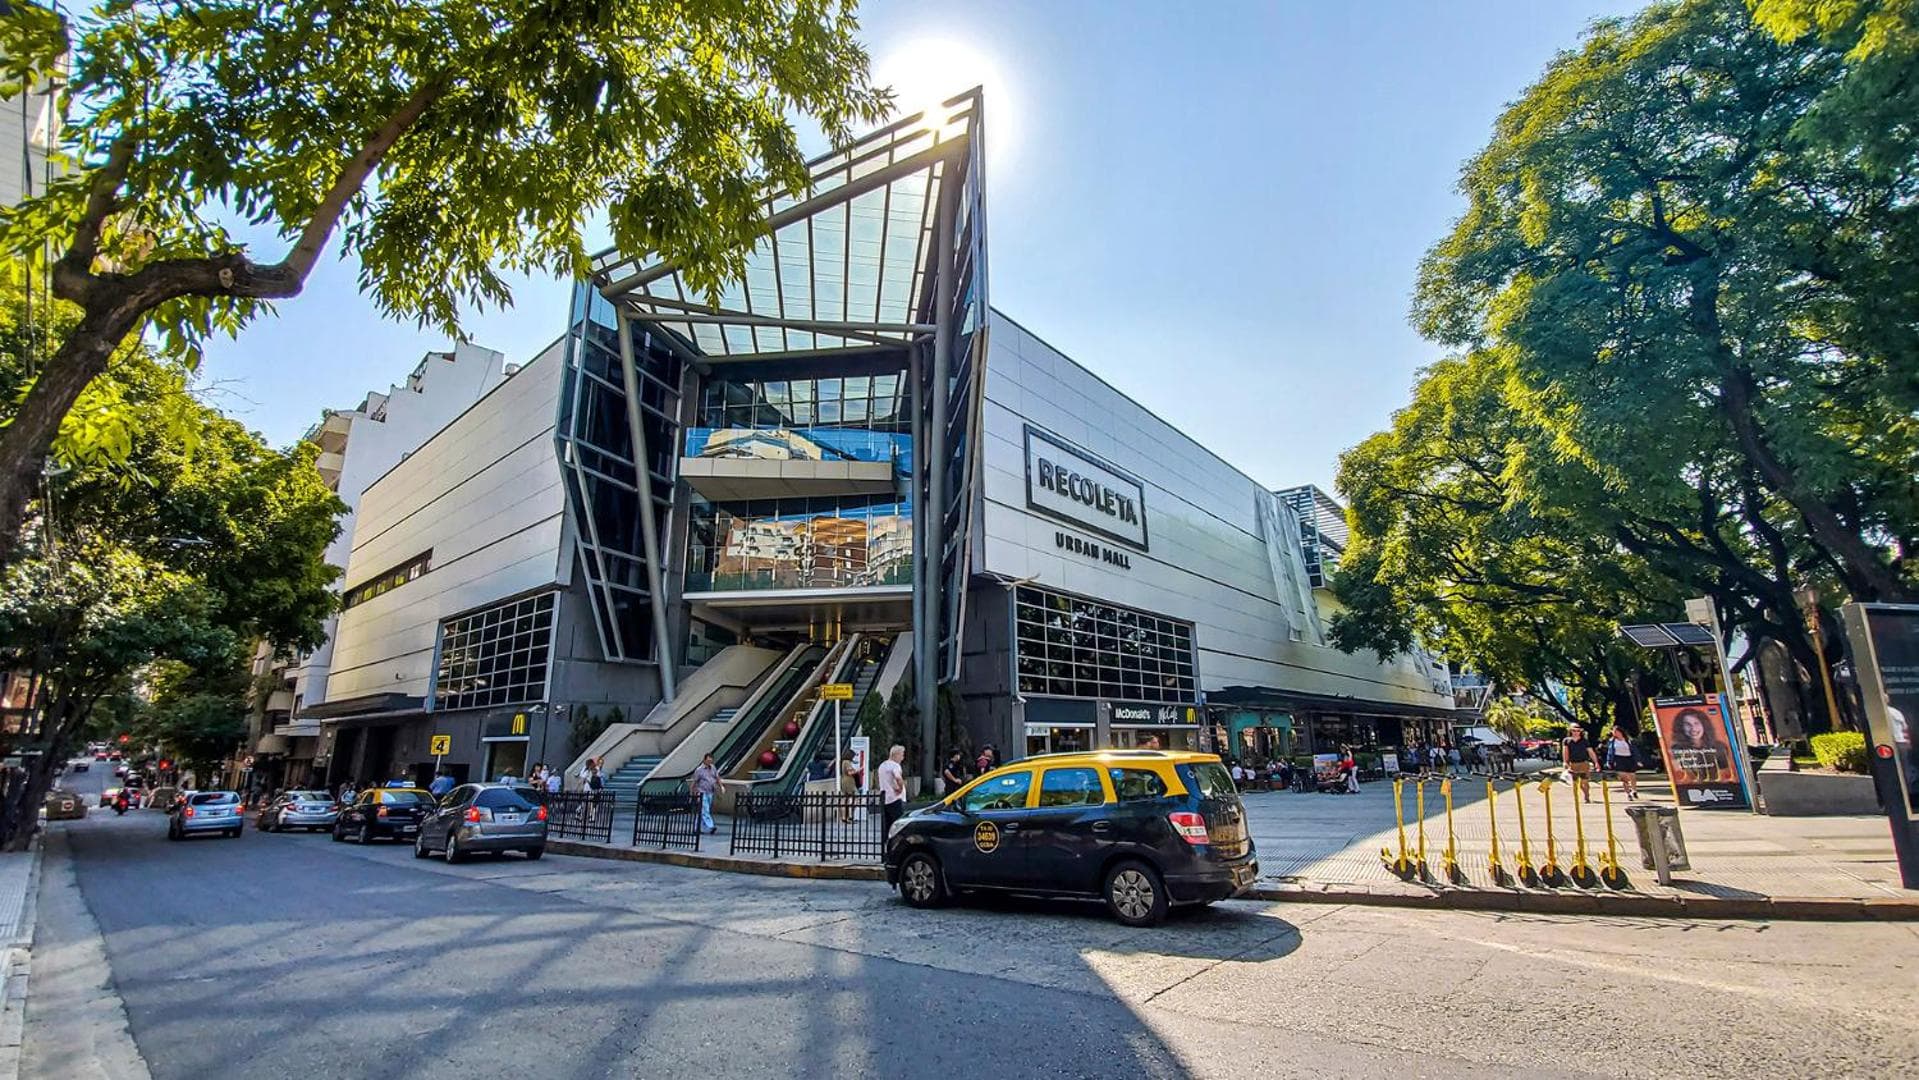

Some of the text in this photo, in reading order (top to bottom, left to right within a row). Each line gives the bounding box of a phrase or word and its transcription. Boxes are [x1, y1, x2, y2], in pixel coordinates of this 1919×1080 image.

[1038, 457, 1138, 526] RECOLETA
[1055, 531, 1131, 570] URBAN MALL
[436, 740, 445, 752] 4
[1687, 788, 1719, 802] BA
